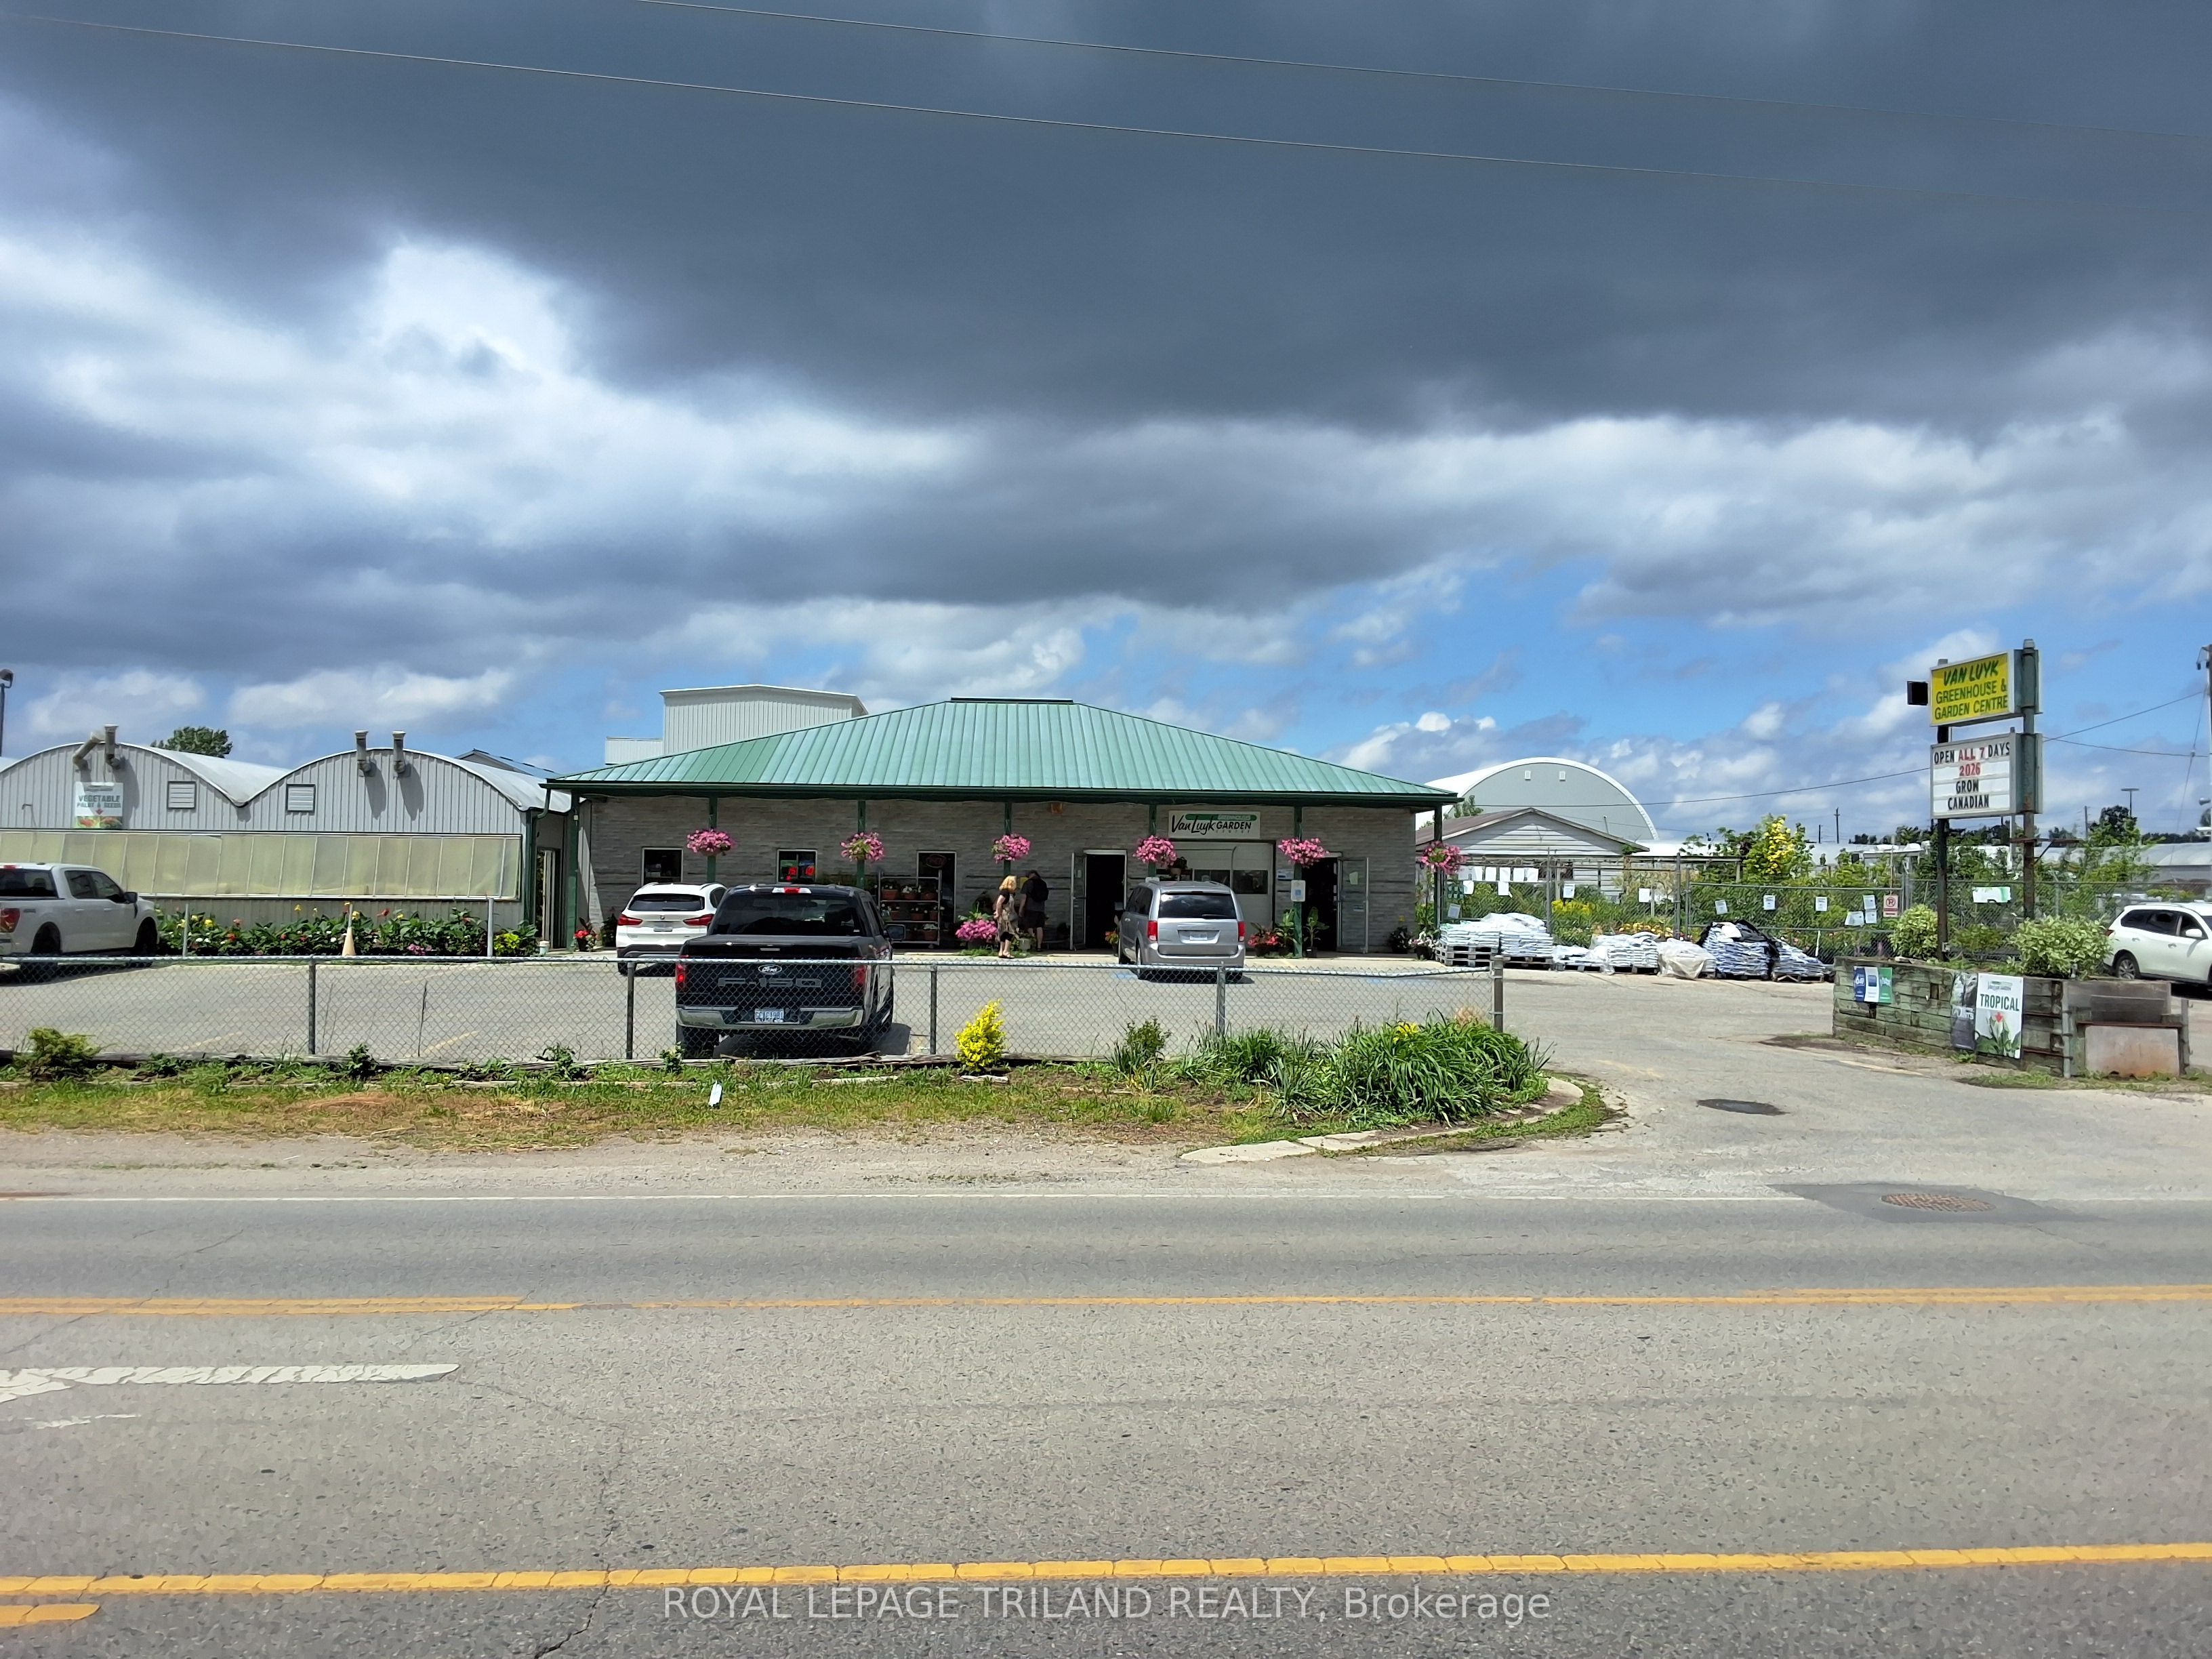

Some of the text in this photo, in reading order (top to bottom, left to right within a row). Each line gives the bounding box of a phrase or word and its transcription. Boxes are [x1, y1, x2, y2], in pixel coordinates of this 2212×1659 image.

[1944, 660, 1999, 687] VAN LUYK
[1936, 678, 2007, 704] GREENHOUSE &
[1935, 695, 2008, 720] GARDEN CENTRE
[1934, 742, 2010, 764] OPEN ALL 7 DAYS
[1959, 762, 1981, 777] 2026
[1956, 779, 1979, 794] GROW
[1948, 794, 1990, 811] CANADIAN
[1172, 815, 1252, 835] Van Luyk GARDEN
[718, 977, 822, 987] F-150
[1980, 994, 2020, 1012] TROPICAL
